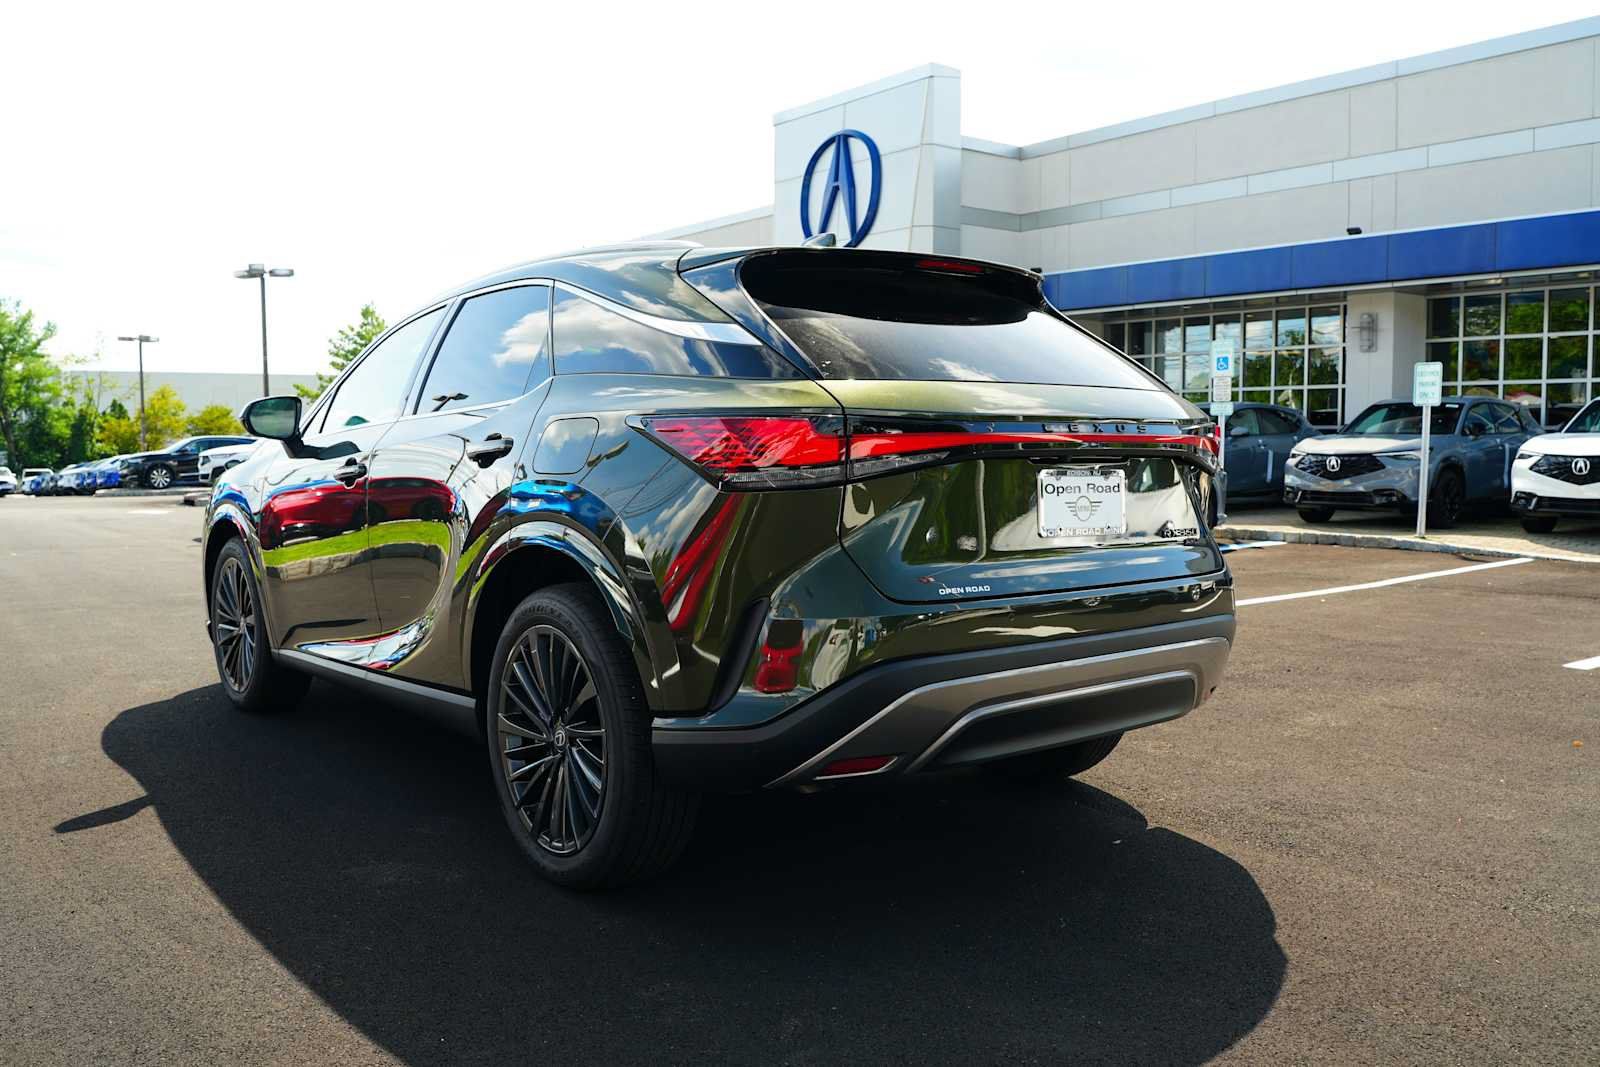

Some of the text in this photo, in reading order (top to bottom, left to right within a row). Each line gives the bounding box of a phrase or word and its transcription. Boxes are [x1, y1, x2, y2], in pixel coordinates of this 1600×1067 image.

[1041, 423, 1147, 433] LEXUS
[1045, 483, 1120, 496] Open Road
[1047, 528, 1074, 537] OPEN
[1076, 528, 1102, 536] ROAD
[939, 585, 991, 595] OPEN ROAD
